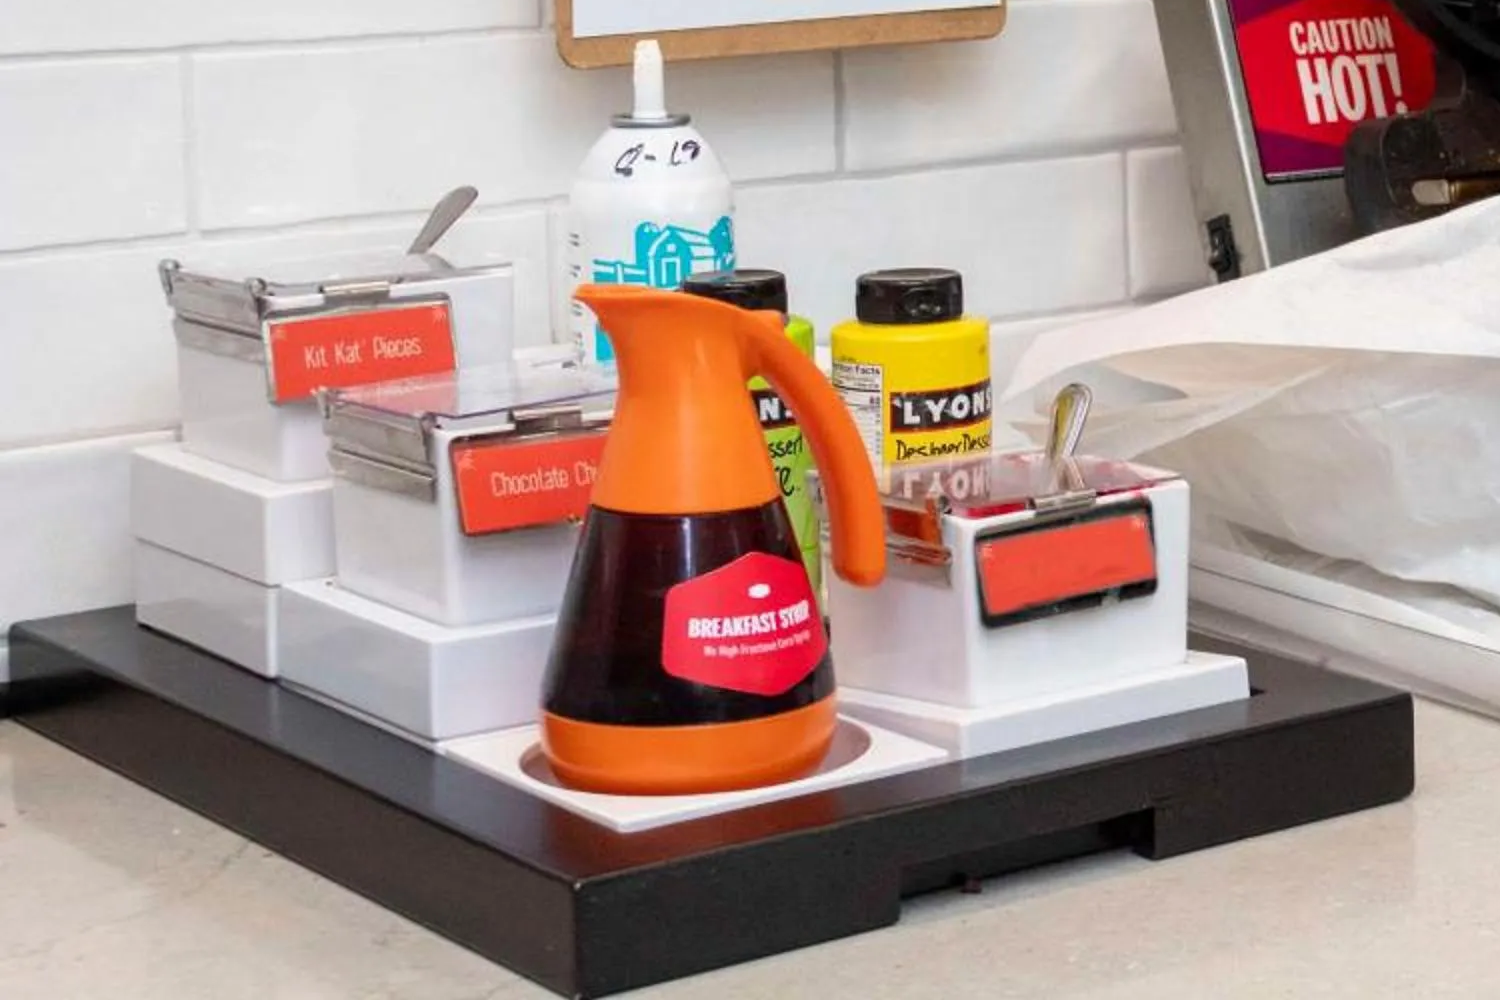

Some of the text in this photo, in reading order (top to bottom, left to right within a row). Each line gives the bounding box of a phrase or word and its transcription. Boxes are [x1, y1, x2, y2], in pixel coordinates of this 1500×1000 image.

[1289, 15, 1395, 56] CAUTION
[1296, 52, 1408, 125] HOT!
[304, 345, 329, 369] Kit
[372, 335, 423, 361] Pieces
[490, 466, 568, 498] Chocolate
[687, 611, 777, 639] BREAKFAST
